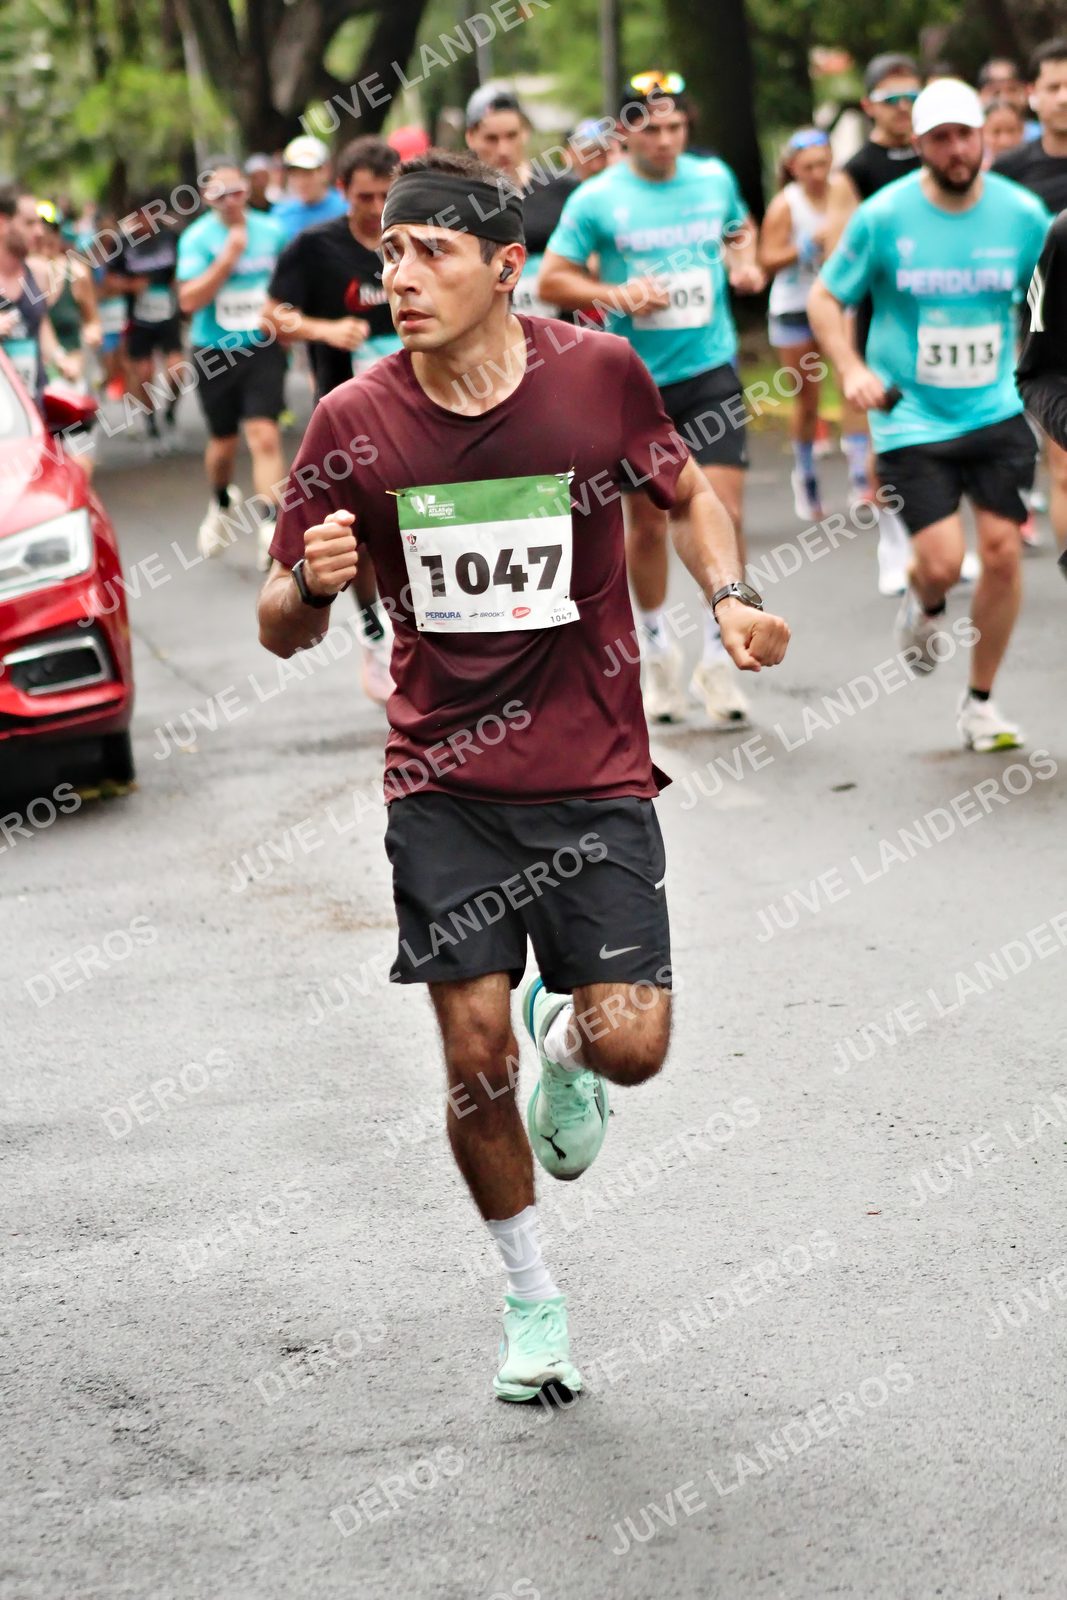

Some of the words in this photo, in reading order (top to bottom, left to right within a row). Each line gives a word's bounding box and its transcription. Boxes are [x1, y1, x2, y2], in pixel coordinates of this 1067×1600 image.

[673, 286, 705, 308] 05
[925, 343, 994, 367] 3113
[421, 544, 562, 597] 1047
[425, 611, 461, 619] PERDURA
[550, 612, 572, 623] 1047
